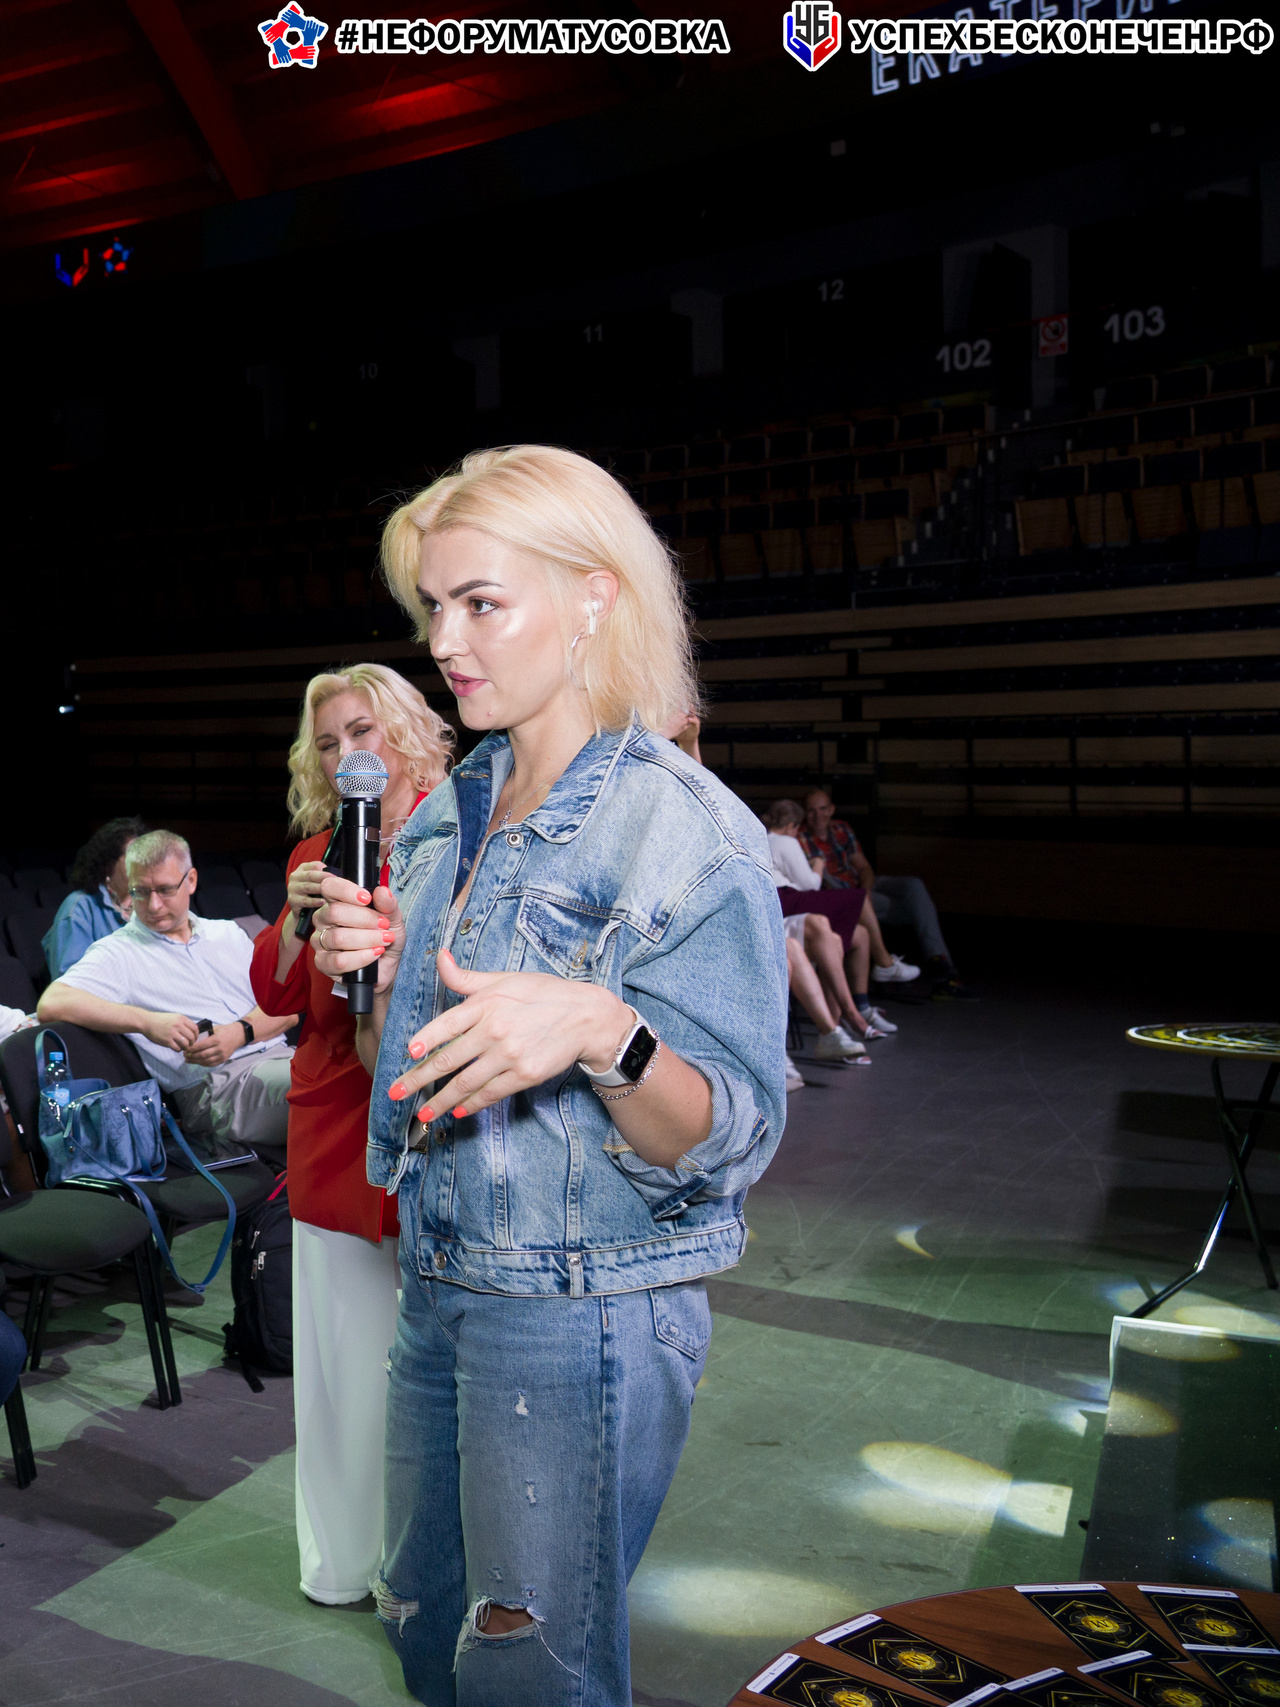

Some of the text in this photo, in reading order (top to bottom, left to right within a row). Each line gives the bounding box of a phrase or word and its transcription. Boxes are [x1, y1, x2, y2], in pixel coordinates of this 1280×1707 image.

[819, 279, 844, 302] 12
[583, 323, 603, 343] 11
[1103, 305, 1167, 344] 103
[935, 337, 992, 373] 102
